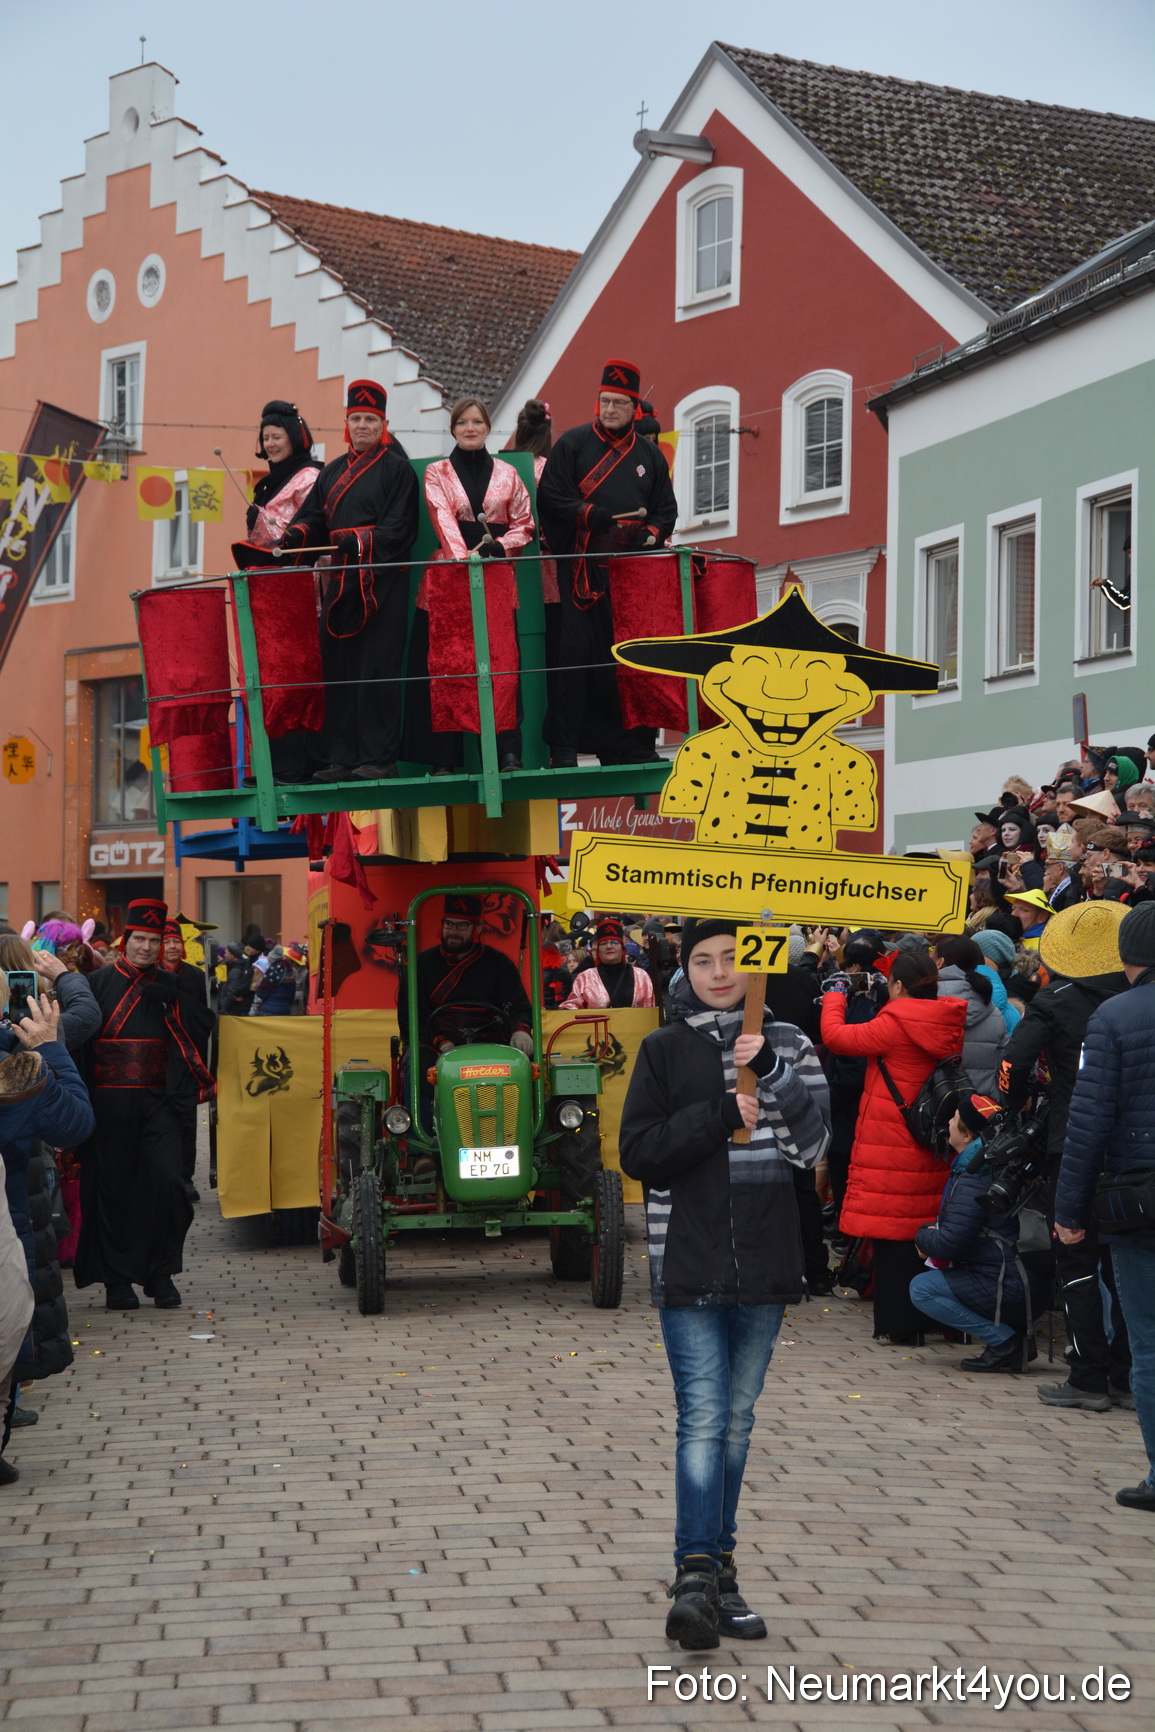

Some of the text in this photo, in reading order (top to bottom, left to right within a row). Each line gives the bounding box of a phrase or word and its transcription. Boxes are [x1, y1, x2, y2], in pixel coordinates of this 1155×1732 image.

[587, 796, 625, 831] Mode
[90, 840, 165, 867] GÖTZ
[605, 863, 928, 902] Stammtisch Pfennigfuchser
[740, 934, 787, 966] 27
[462, 1066, 509, 1077] Holder
[998, 1059, 1013, 1094] TEAM
[470, 1164, 488, 1176] EP
[473, 1150, 492, 1162] NM
